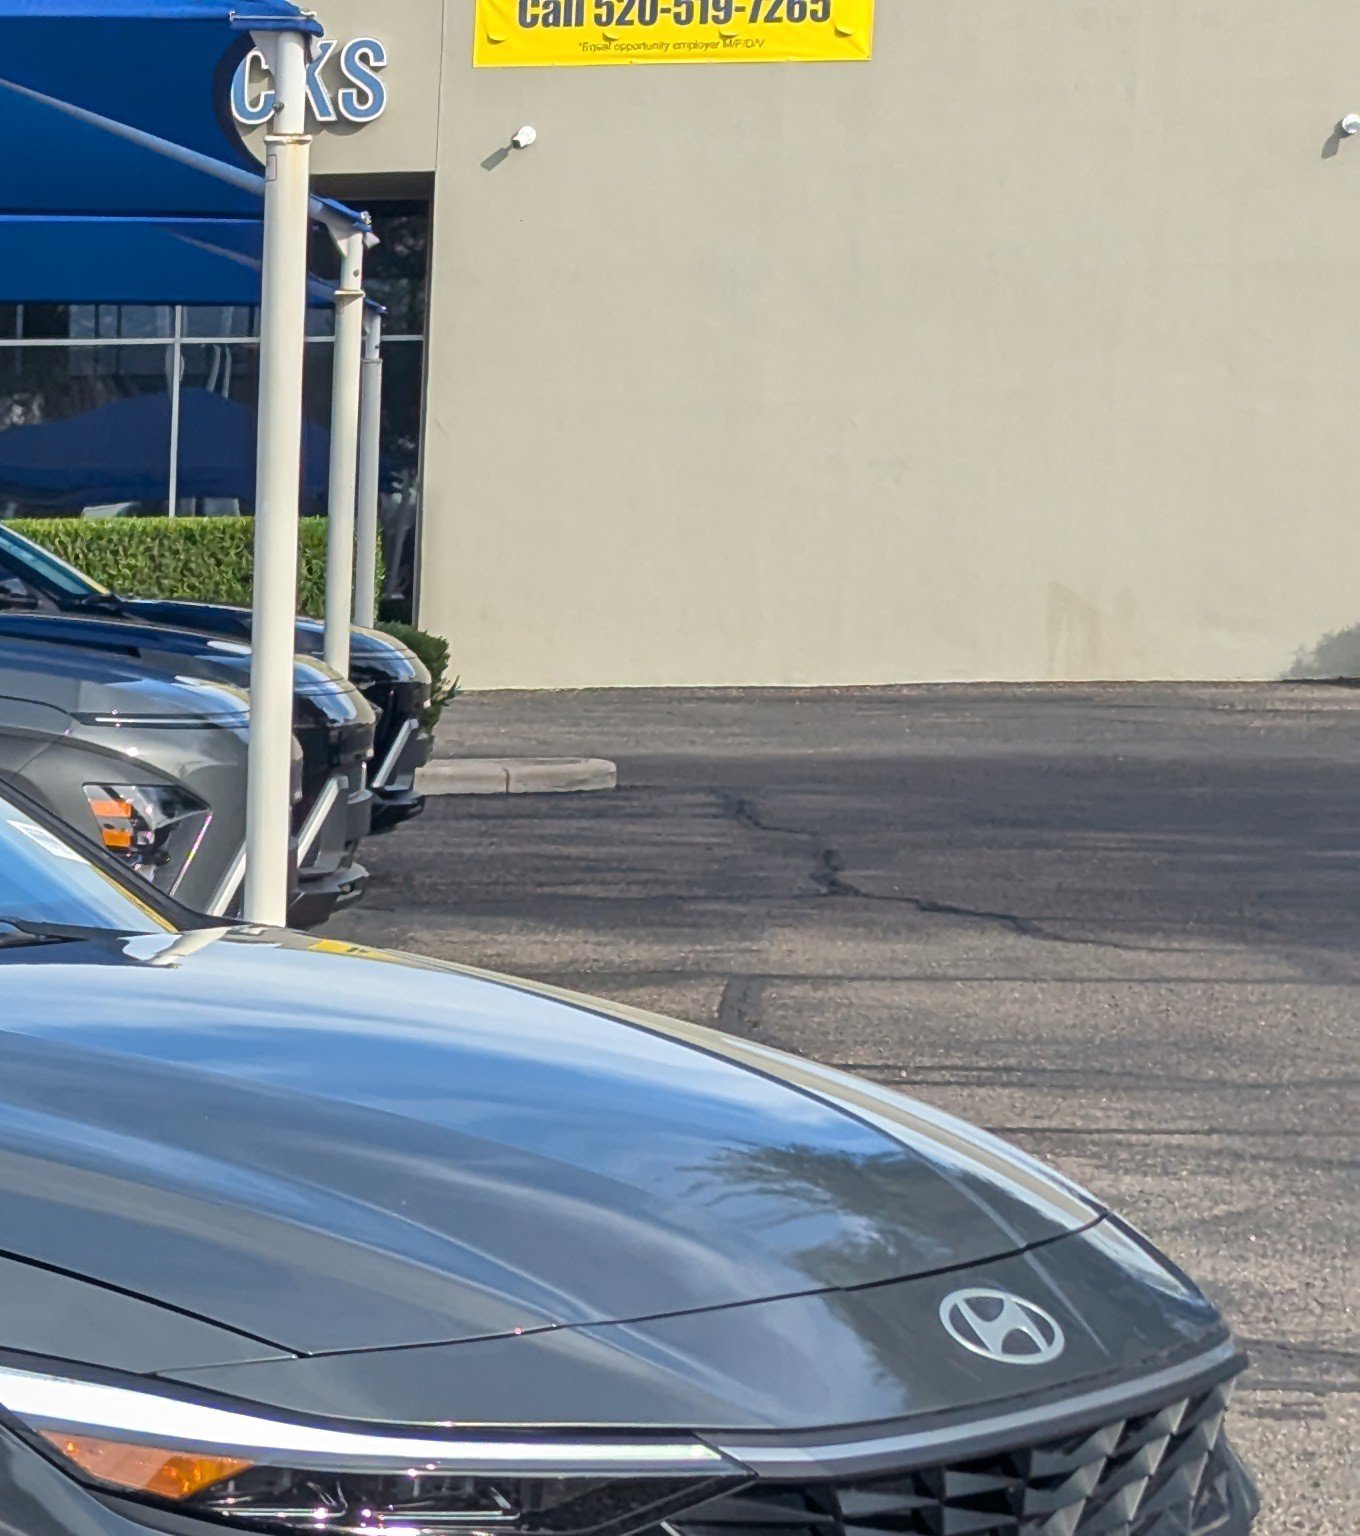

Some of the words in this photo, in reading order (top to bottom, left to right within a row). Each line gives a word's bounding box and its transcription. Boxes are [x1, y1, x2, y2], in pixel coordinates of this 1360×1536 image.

[518, 0, 584, 28] Call
[594, 0, 831, 27] 520-519-7265
[673, 40, 720, 51] employer
